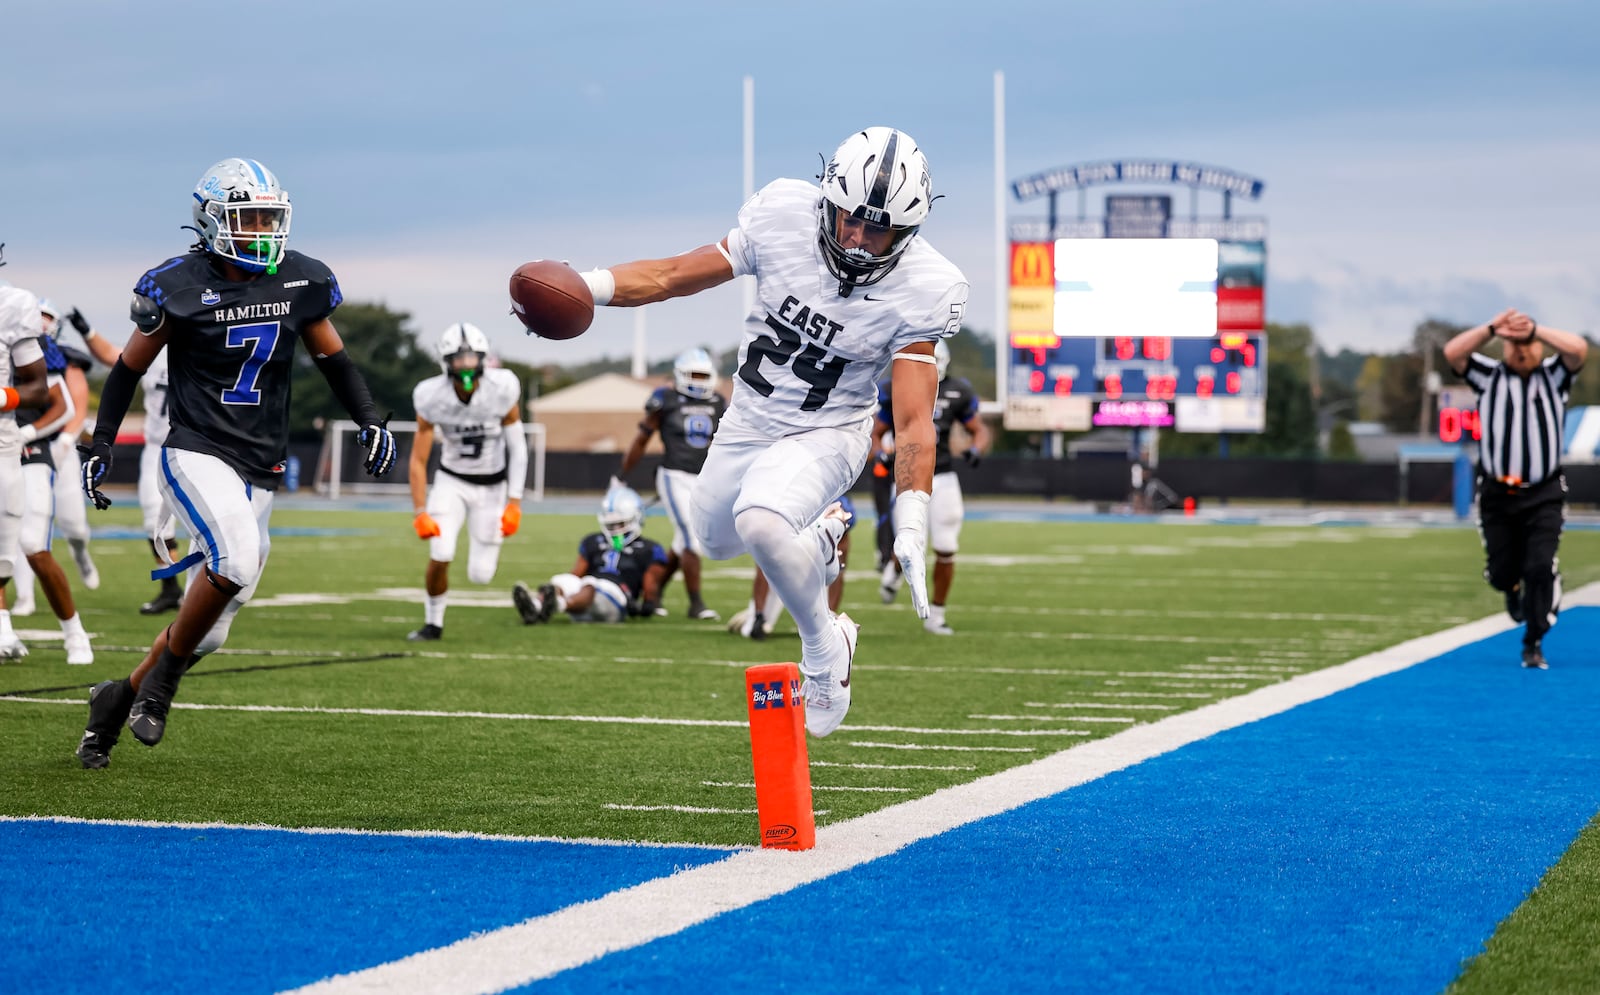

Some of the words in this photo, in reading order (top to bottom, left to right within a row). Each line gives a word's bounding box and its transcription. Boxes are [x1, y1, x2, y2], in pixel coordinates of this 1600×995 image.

[204, 176, 225, 200] Blue
[215, 301, 291, 322] HAMILTON
[779, 295, 844, 347] EAST
[220, 320, 281, 406] 7
[738, 311, 855, 412] 24
[753, 691, 766, 705] Big
[767, 690, 784, 701] Blue
